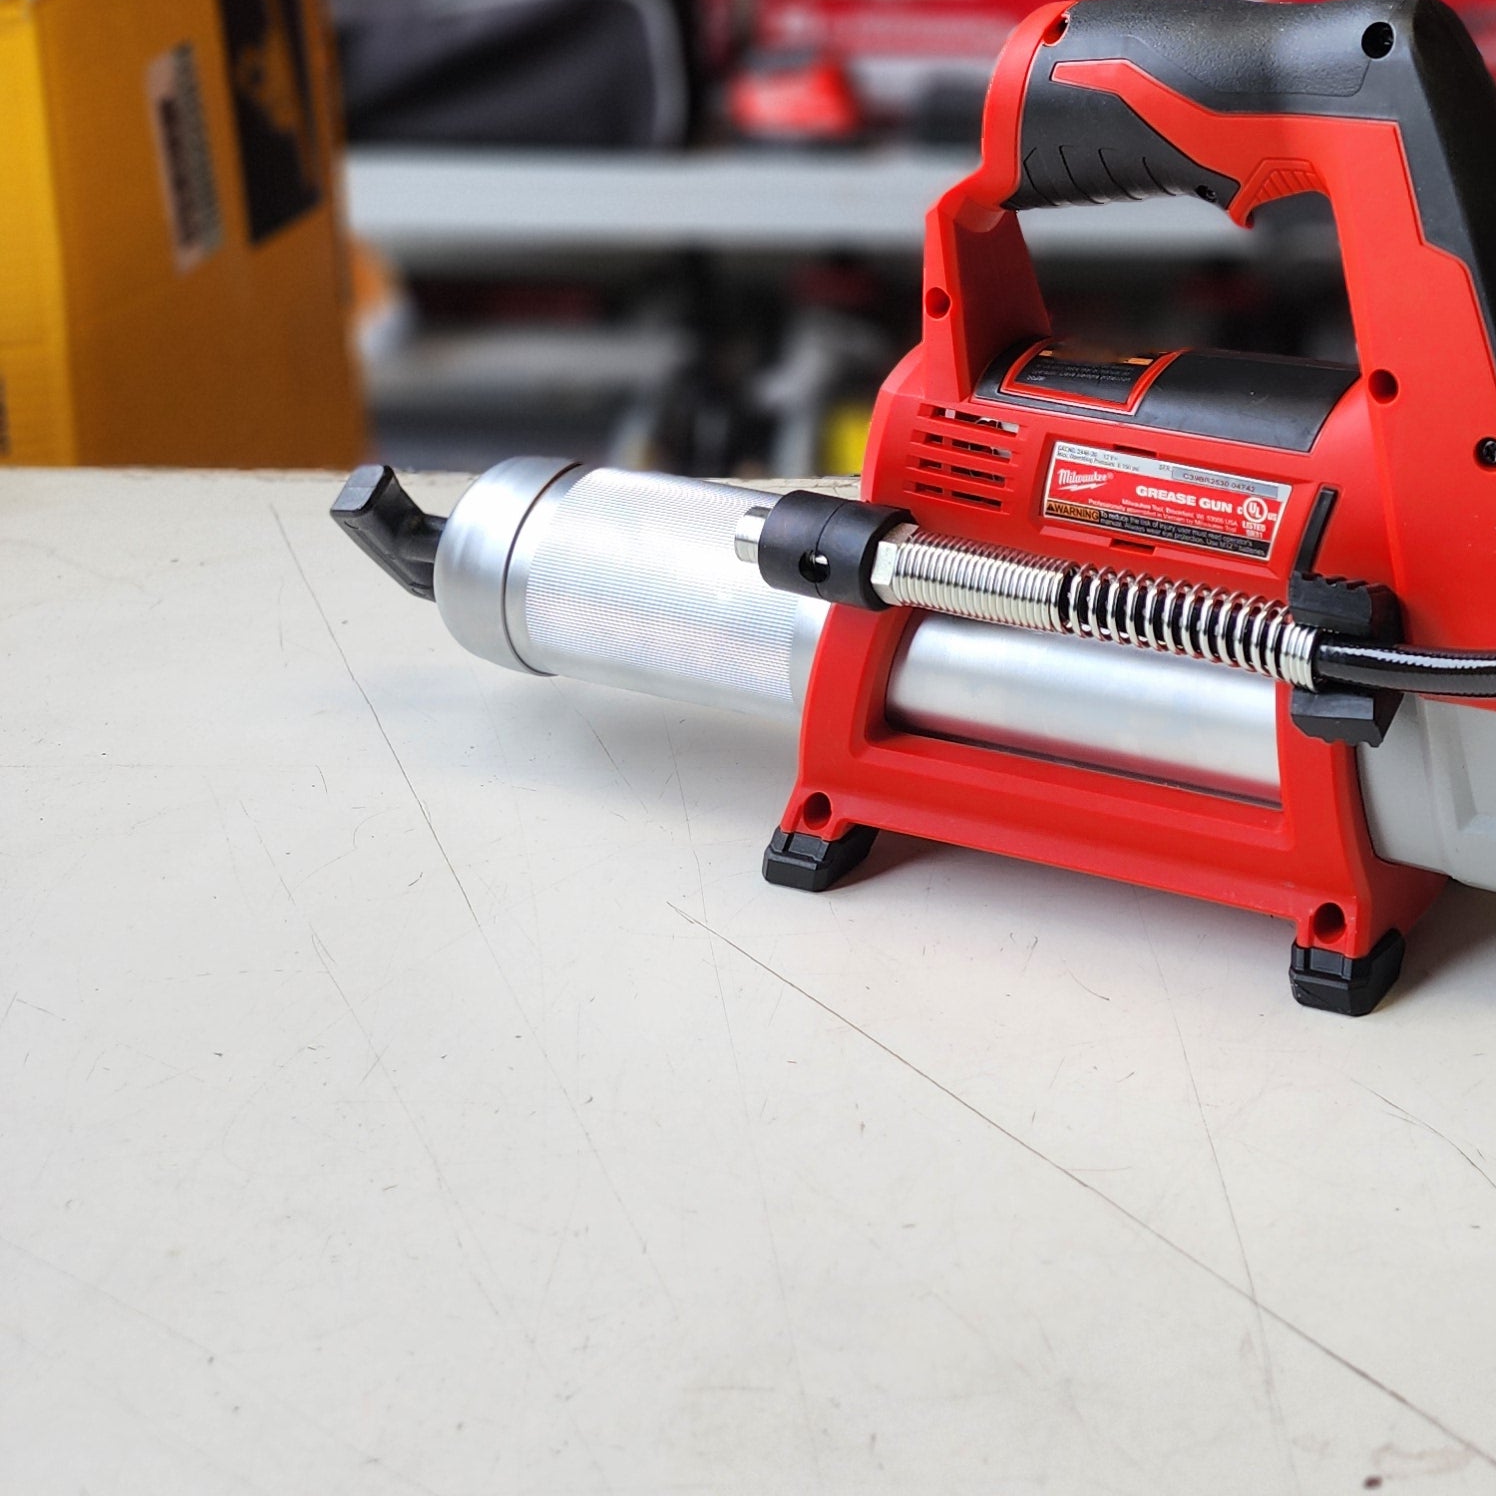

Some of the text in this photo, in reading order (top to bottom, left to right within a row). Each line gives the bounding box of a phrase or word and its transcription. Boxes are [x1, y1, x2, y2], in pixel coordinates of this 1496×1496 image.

[1135, 485, 1233, 514] GREASE GUN
[1054, 504, 1099, 520] WARNING
[1108, 512, 1128, 521] reduce
[1242, 520, 1266, 532] LISTED
